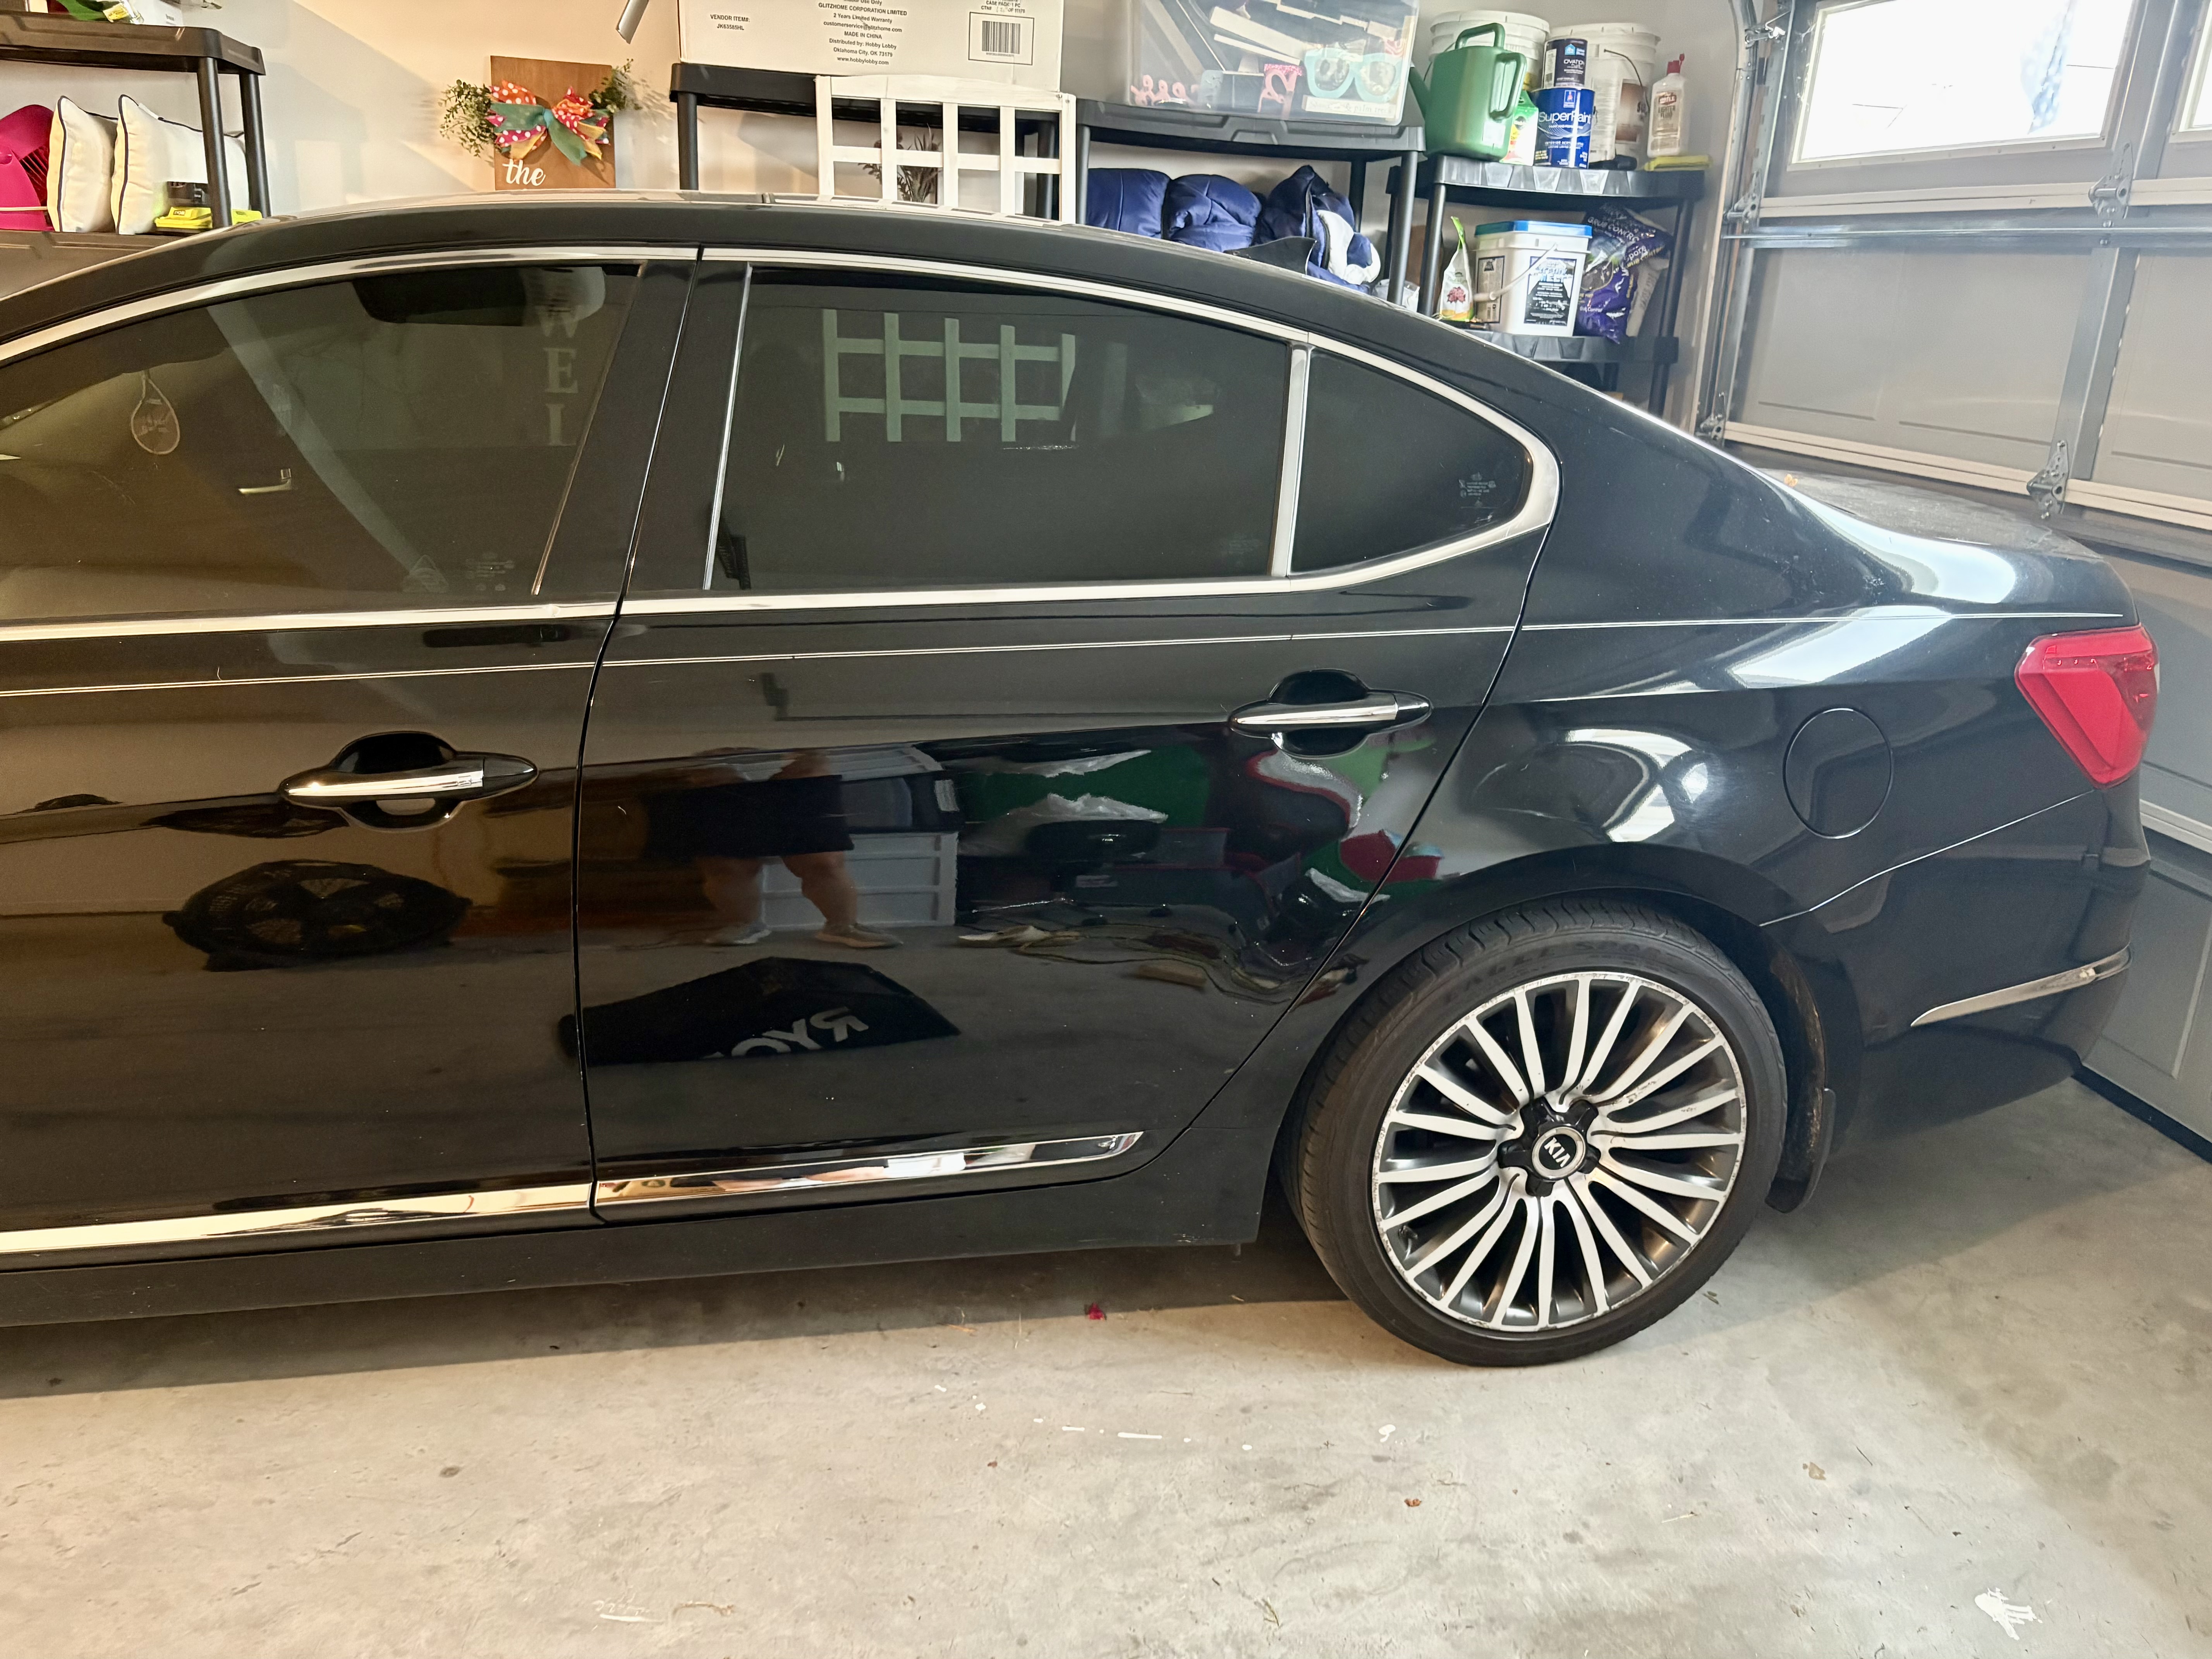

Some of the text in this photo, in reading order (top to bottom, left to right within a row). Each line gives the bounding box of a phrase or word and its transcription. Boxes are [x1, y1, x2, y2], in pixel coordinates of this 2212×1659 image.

[849, 5, 886, 14] CORPORATION
[837, 57, 889, 65] www.hobbylobby.com
[502, 159, 546, 186] the
[1544, 1137, 1570, 1168] KIA
